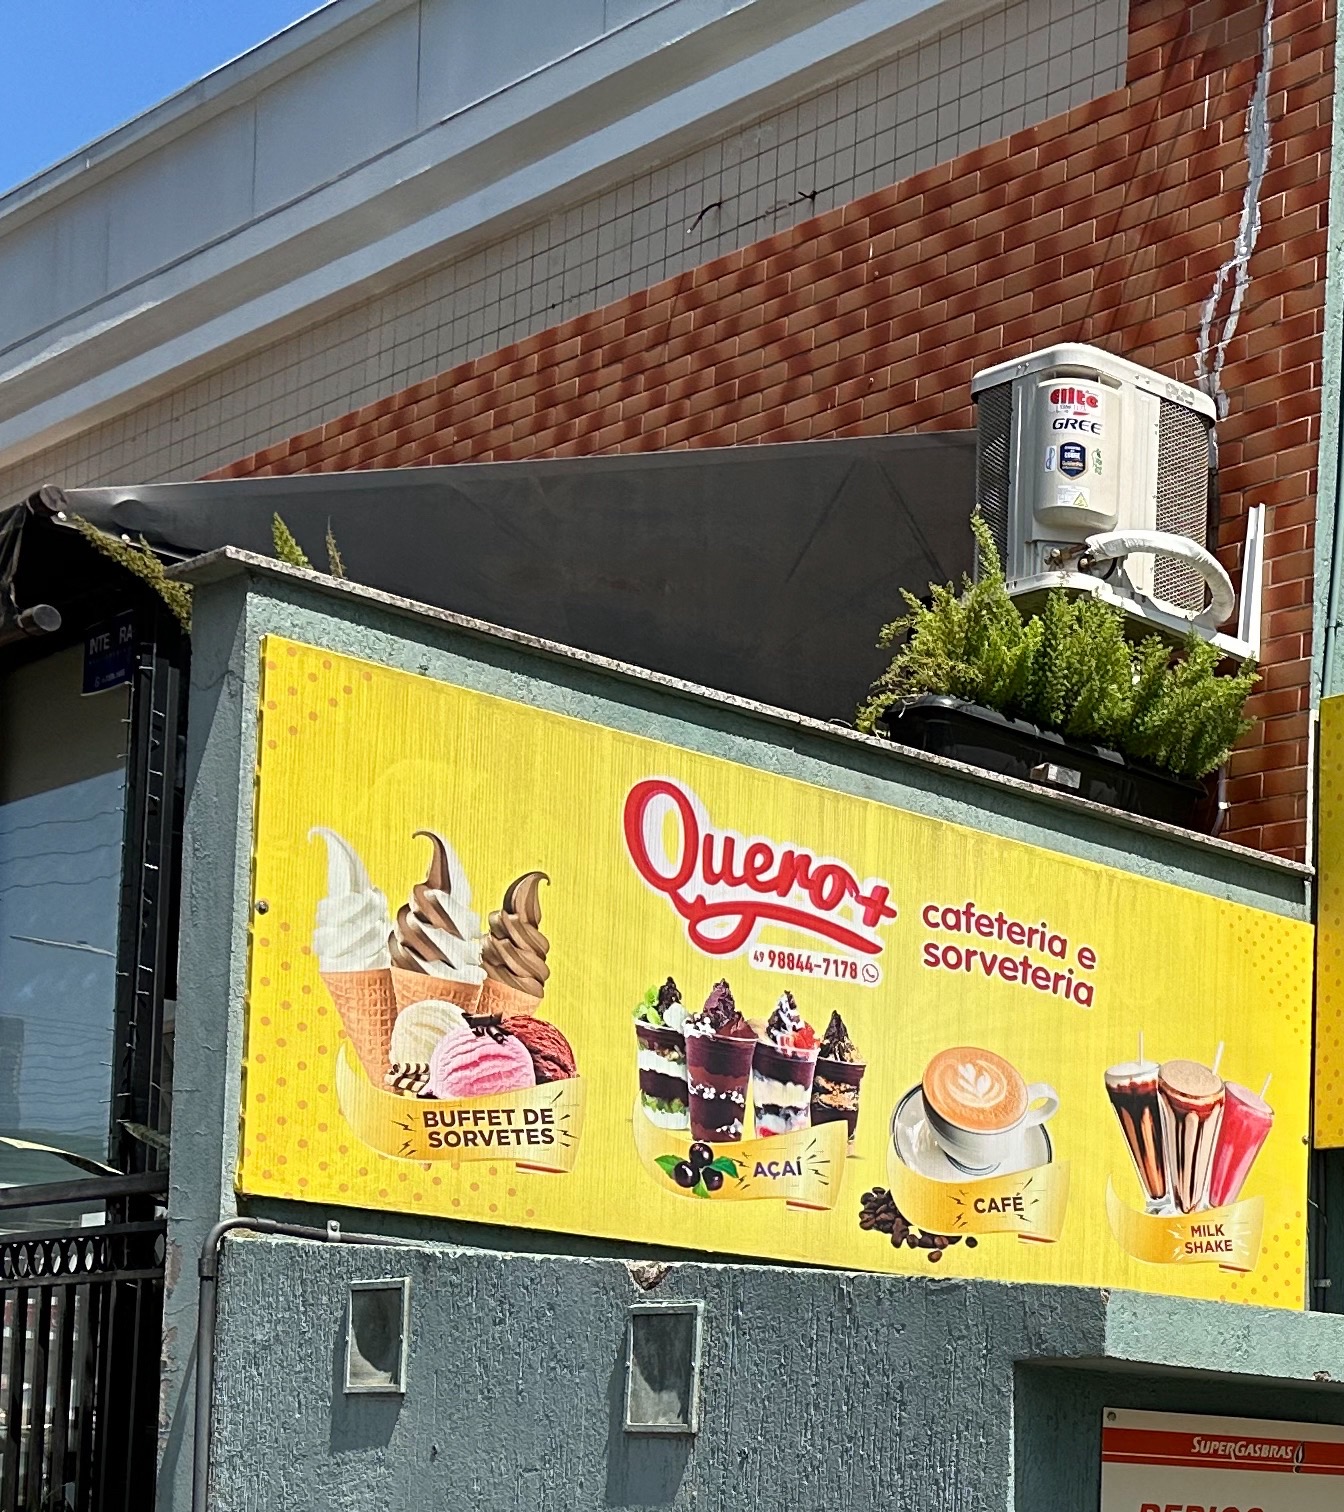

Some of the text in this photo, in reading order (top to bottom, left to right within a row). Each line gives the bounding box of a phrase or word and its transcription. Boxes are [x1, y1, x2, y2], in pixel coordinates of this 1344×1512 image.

[1052, 417, 1103, 436] GREE
[922, 902, 1097, 970] cafeteria e
[753, 949, 859, 980] 49 98844-7178
[923, 942, 1095, 1008] sorveteria
[422, 1107, 555, 1129] BUFFET DE
[427, 1128, 555, 1149] SORVETES
[753, 1156, 803, 1181] AÇAÍ
[973, 1192, 1025, 1214] CAFÉ
[1190, 1223, 1226, 1238] MILK
[1184, 1239, 1234, 1255] SHAKE
